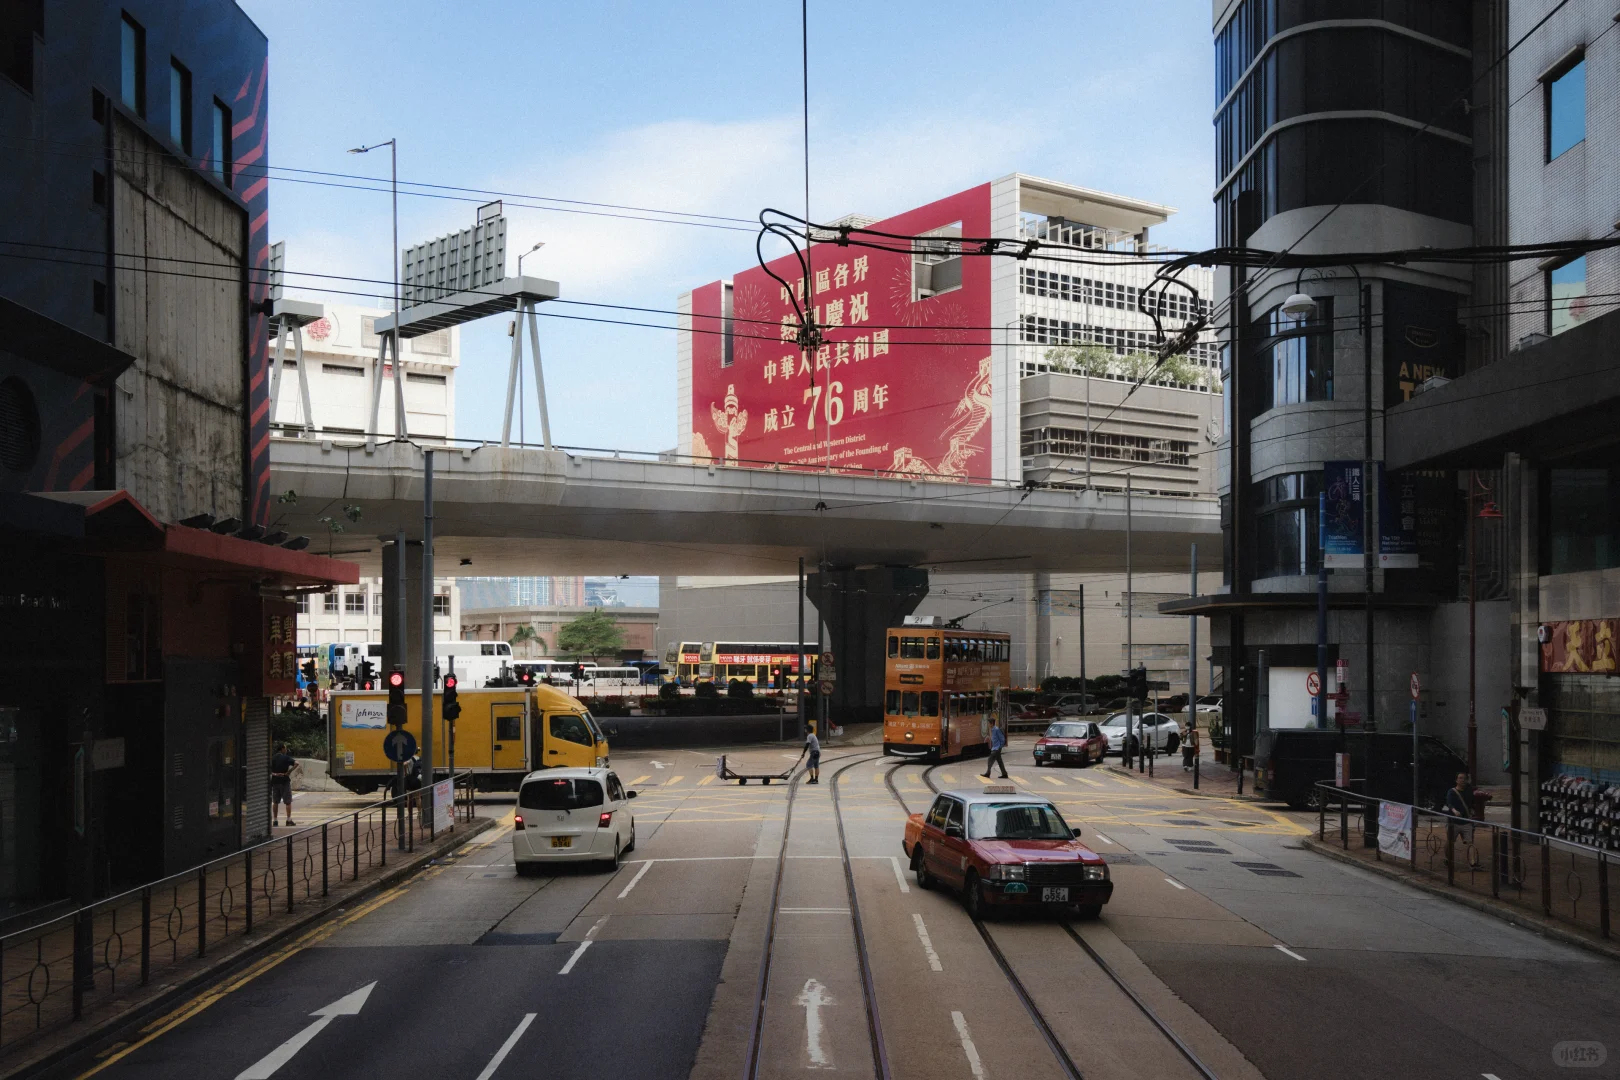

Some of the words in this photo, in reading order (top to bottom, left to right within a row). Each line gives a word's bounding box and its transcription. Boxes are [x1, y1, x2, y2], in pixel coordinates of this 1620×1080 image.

[780, 254, 869, 306] 中西區各界
[763, 328, 890, 385] 中華人民共和國
[1399, 361, 1410, 379] A
[1412, 363, 1446, 380] NEW
[784, 447, 793, 455] The
[794, 443, 812, 453] Central
[812, 441, 823, 450] and
[823, 438, 845, 447] Western
[845, 433, 866, 443] District
[808, 450, 838, 465] Anniversary
[838, 450, 845, 458] of
[845, 448, 855, 458] the
[856, 444, 882, 457] Founding
[882, 442, 889, 452] of
[914, 616, 923, 624] 21
[1044, 894, 1066, 902] 9954
[1050, 887, 1061, 895] EC
